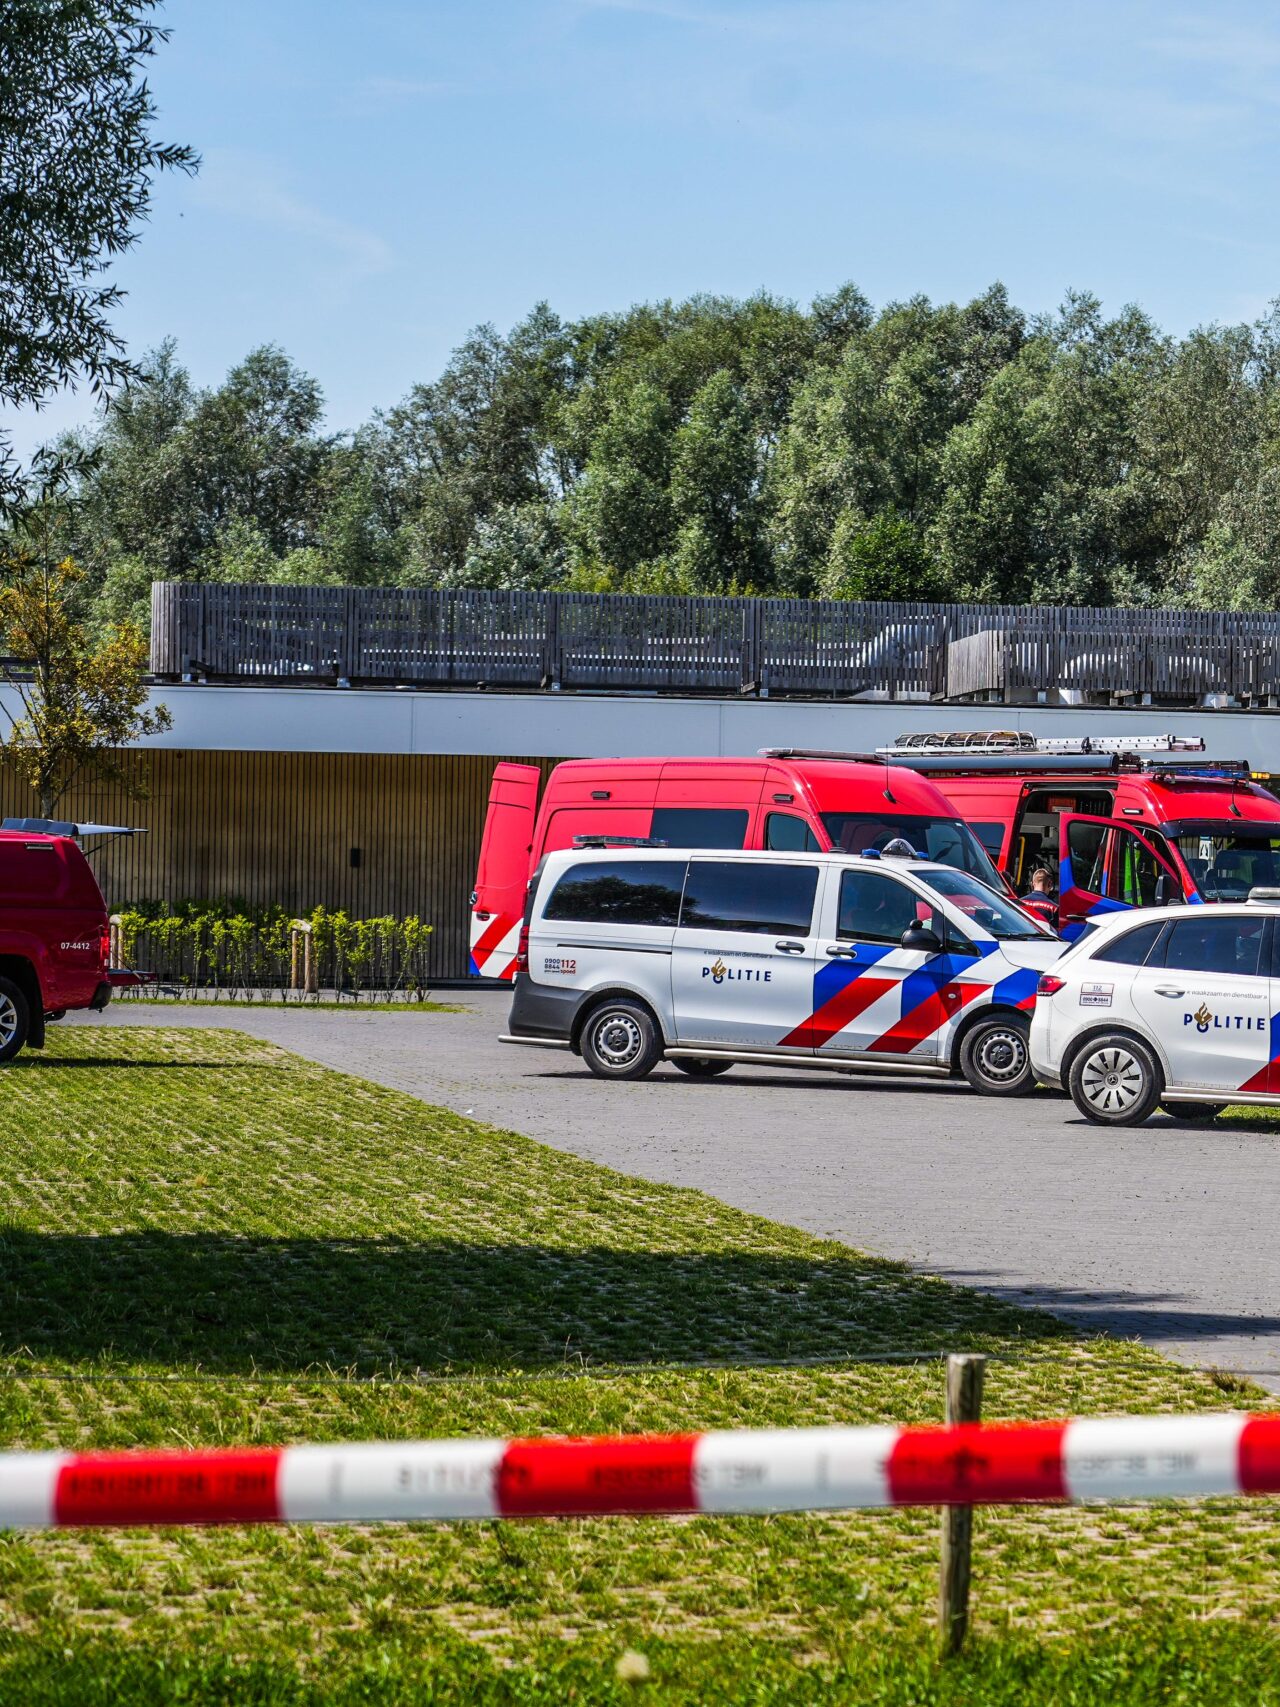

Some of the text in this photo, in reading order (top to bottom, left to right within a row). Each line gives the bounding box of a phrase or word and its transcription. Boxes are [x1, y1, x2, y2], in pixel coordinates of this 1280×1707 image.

[60, 942, 90, 950] 07-4412
[561, 959, 577, 969] 112
[702, 967, 772, 984] POLITIE
[1183, 1013, 1266, 1033] POLITIE
